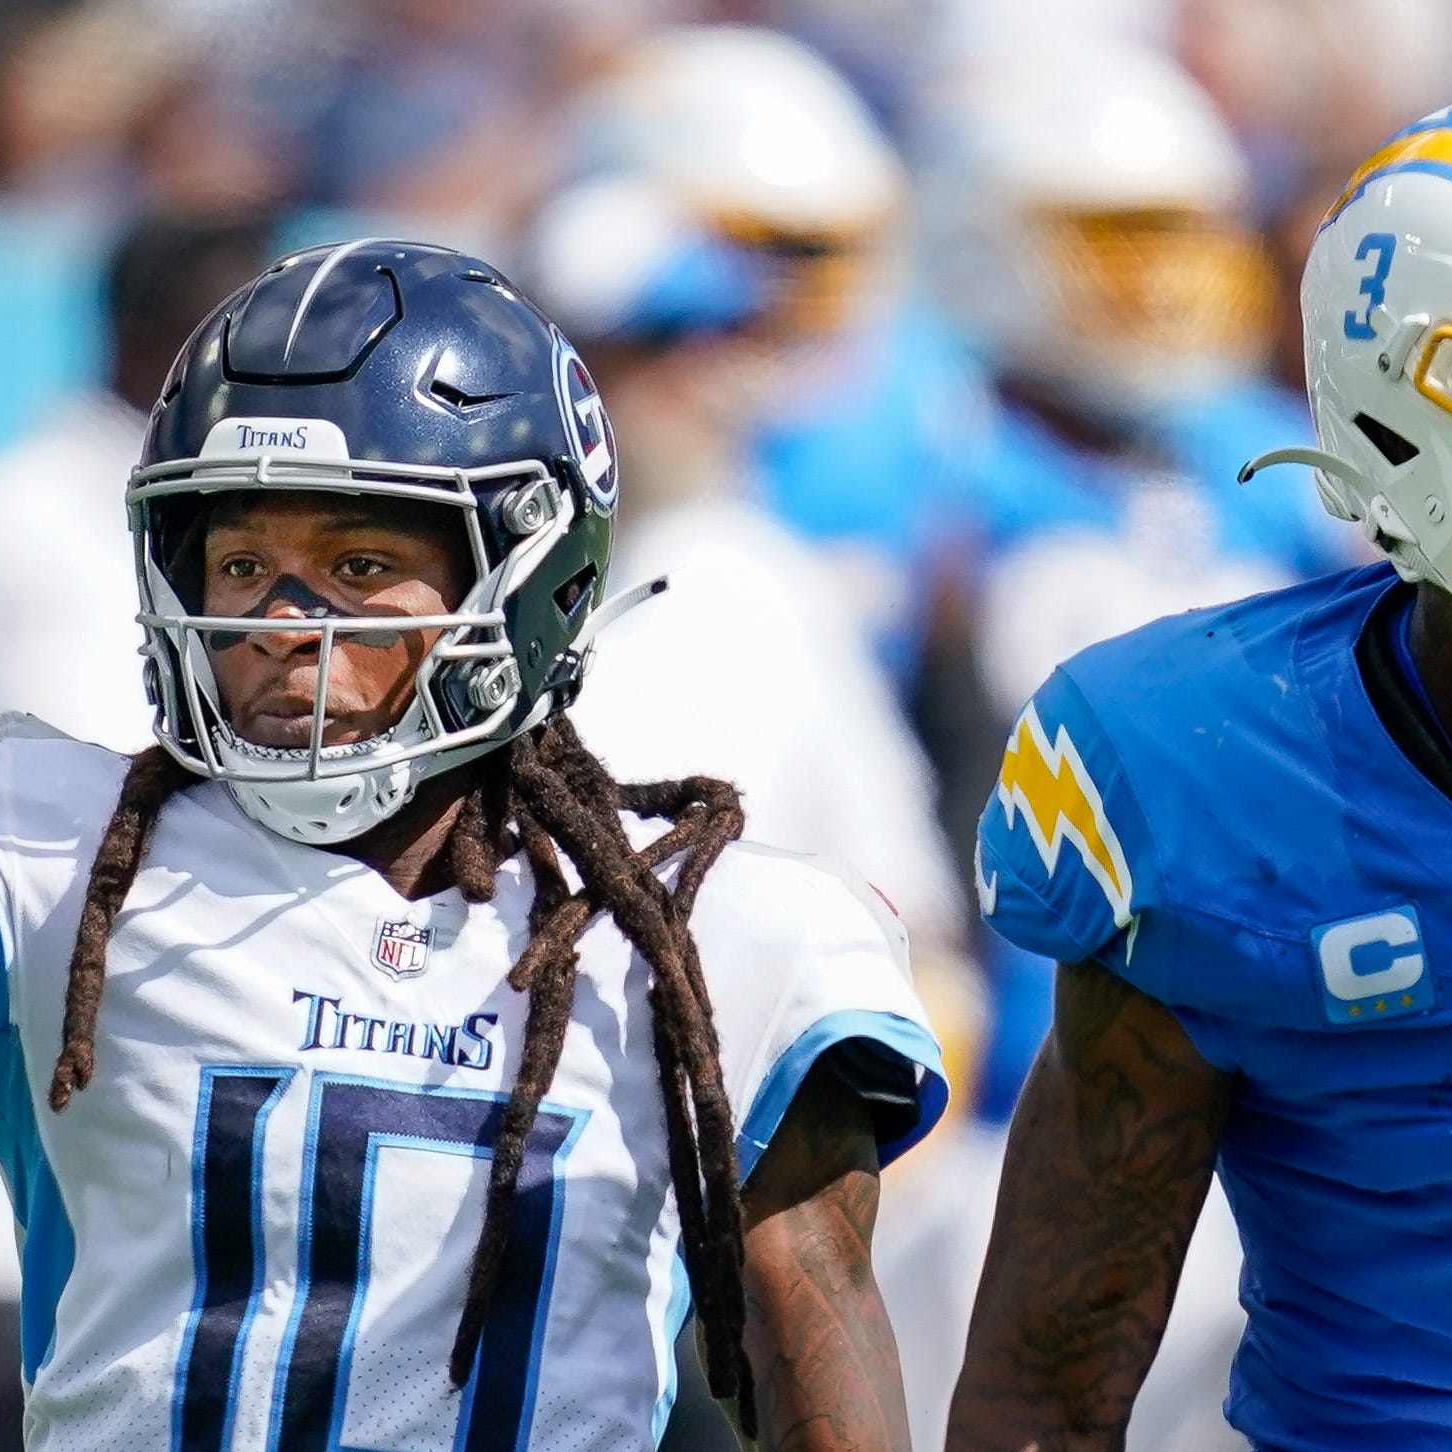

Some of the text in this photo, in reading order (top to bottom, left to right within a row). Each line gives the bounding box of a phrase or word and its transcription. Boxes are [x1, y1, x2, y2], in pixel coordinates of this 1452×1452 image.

[1344, 232, 1396, 340] 3
[379, 937, 421, 968] NFL
[1318, 911, 1425, 1001] C
